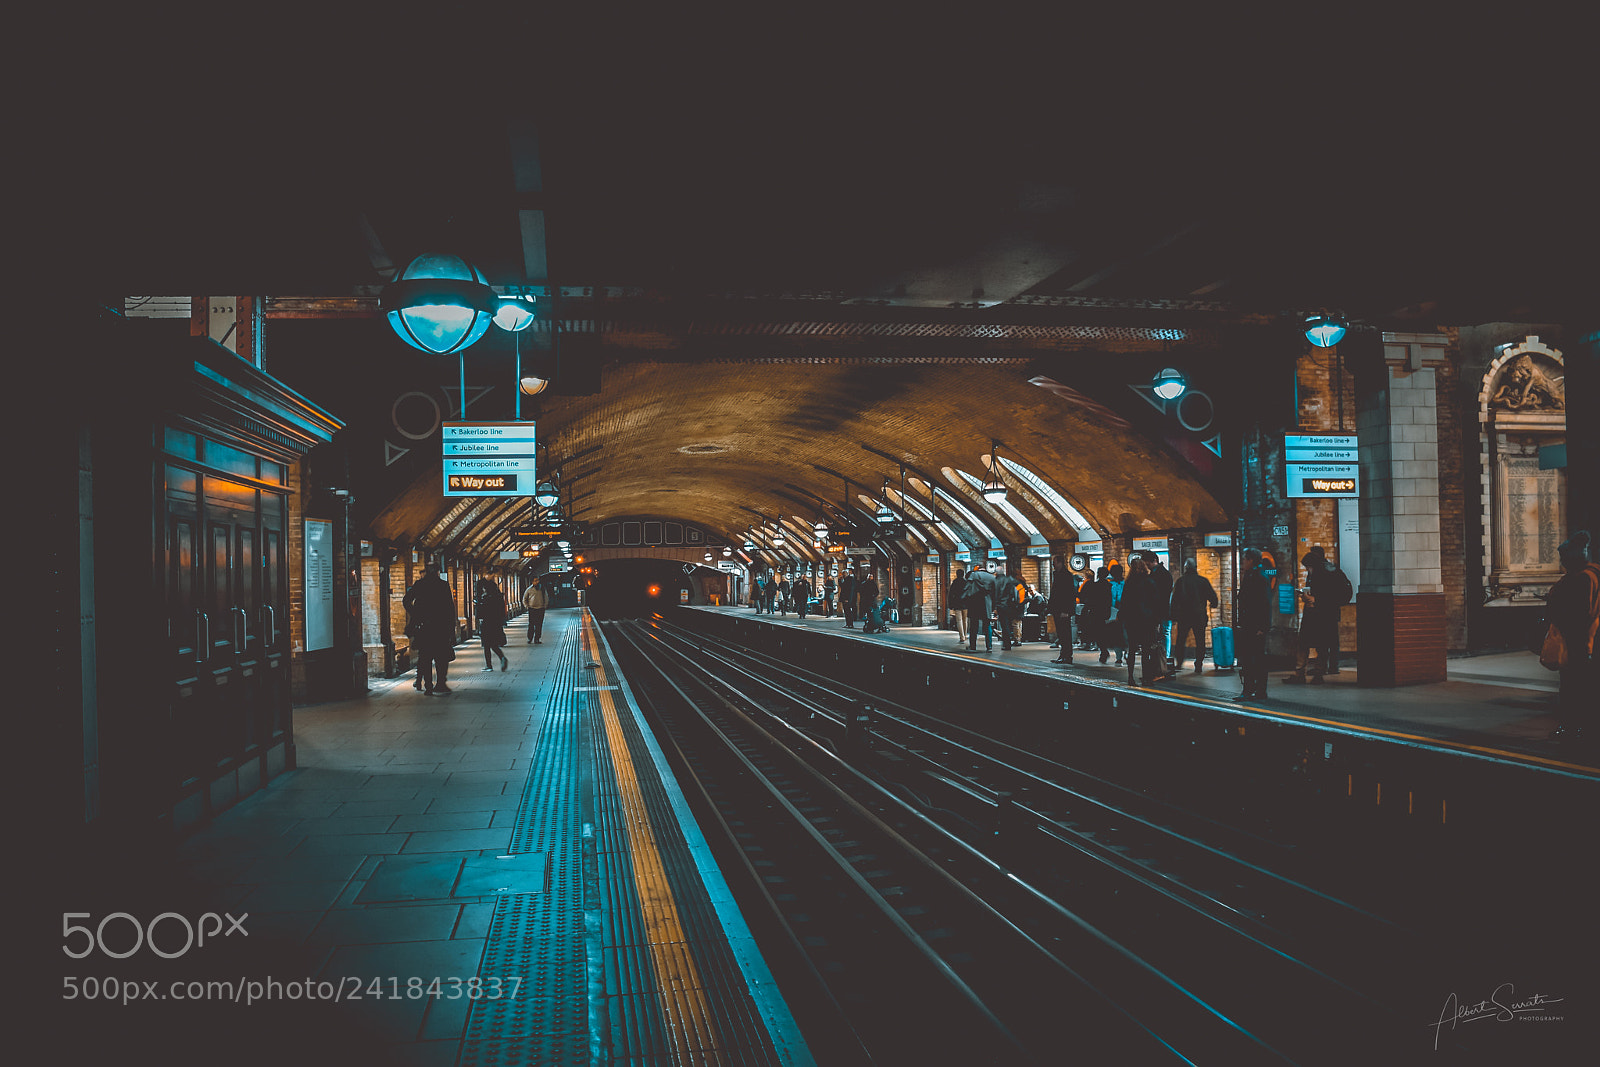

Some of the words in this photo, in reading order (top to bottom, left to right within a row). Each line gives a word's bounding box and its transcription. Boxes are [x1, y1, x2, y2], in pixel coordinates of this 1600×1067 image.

[461, 477, 484, 489] Way
[485, 477, 505, 487] out
[1312, 480, 1331, 491] Way
[1331, 480, 1346, 490] out
